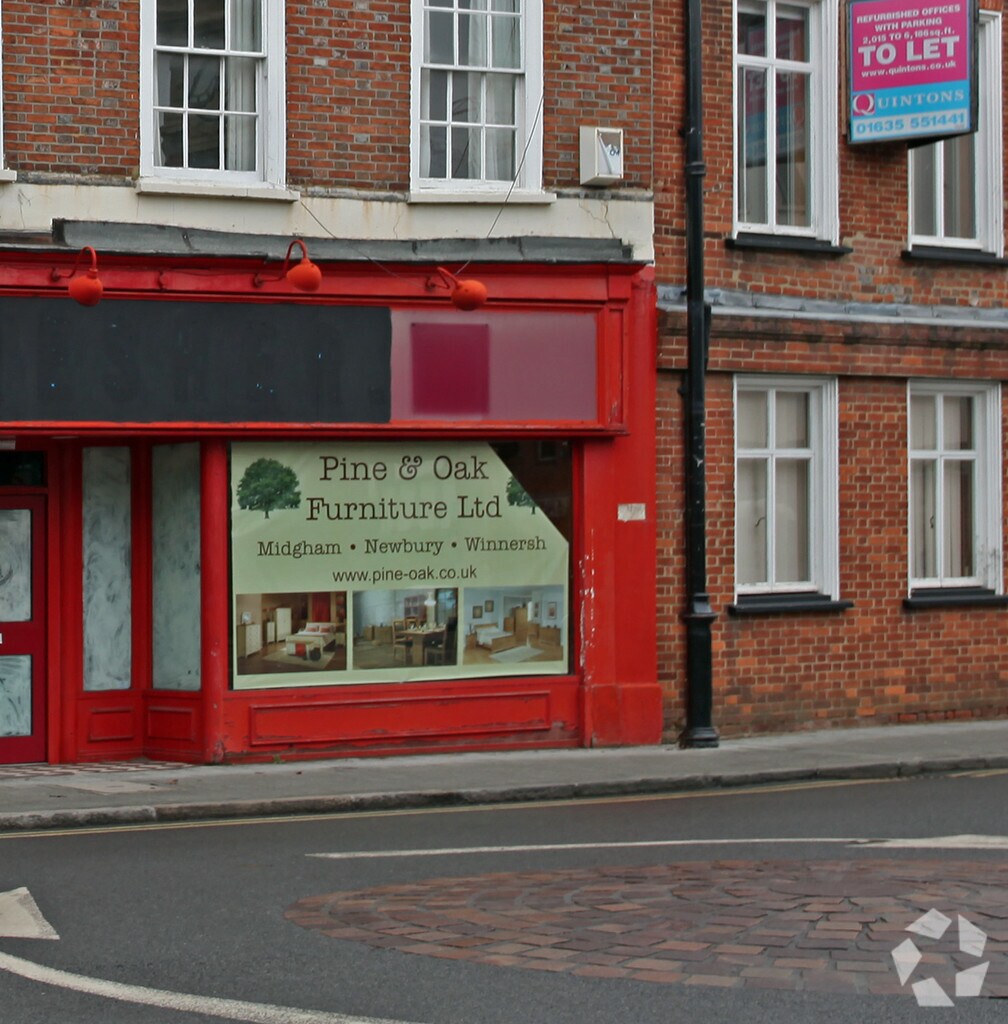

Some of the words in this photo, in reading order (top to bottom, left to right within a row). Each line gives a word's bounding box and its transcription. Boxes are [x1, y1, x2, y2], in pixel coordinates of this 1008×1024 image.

[857, 9, 919, 24] REFURBISHED
[922, 4, 961, 16] OFFICES
[875, 23, 899, 33] WITH
[901, 17, 942, 29] PARKING
[889, 33, 902, 41] TO
[858, 43, 897, 67] TO
[907, 36, 960, 61] LET
[861, 60, 957, 78] www.quintons.co.uk
[853, 89, 965, 115] QUINTONS
[856, 119, 904, 134] 01635
[910, 112, 965, 128] 551441
[319, 456, 387, 480] Pine
[398, 455, 422, 480] &
[433, 455, 489, 480] Oak
[306, 496, 448, 521] Furniture
[457, 495, 502, 519] Ltd
[257, 539, 342, 559] Midgham
[364, 539, 443, 555] Newbury
[465, 536, 547, 552] Winnersh
[332, 565, 477, 584] www.pine-oak.co.uk
